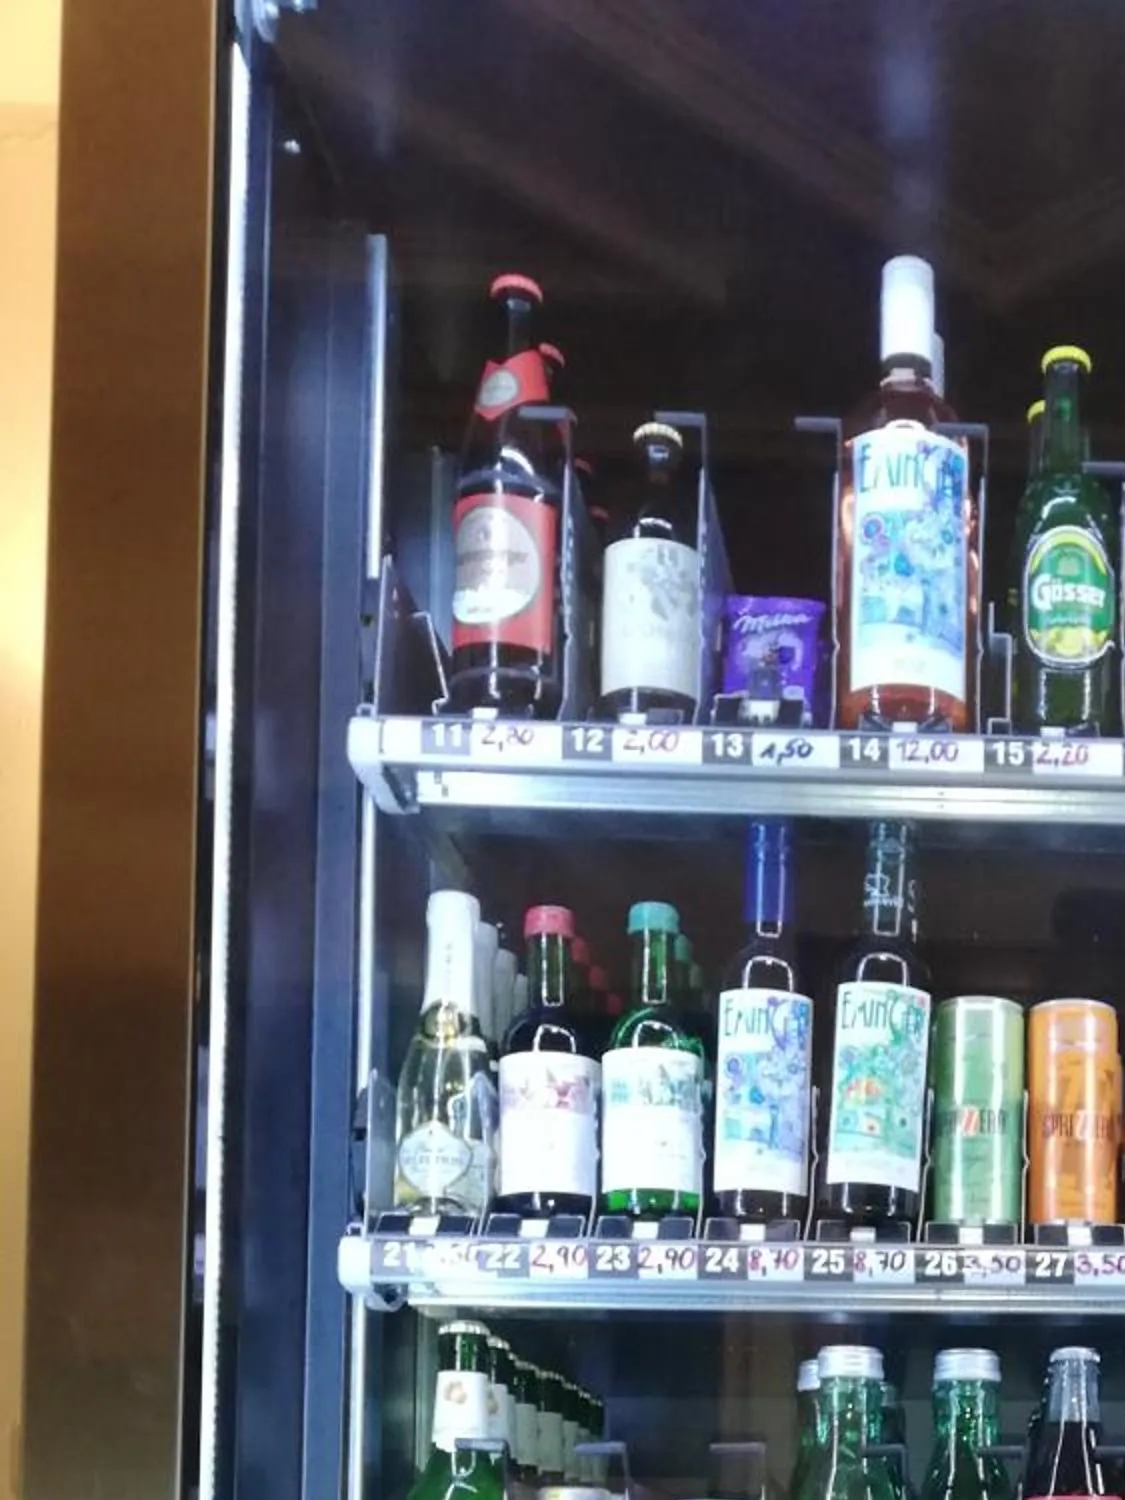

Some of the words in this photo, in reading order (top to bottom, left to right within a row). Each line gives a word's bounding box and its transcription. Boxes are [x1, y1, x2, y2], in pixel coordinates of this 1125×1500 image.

[431, 723, 463, 747] 11
[571, 727, 604, 751] 12
[711, 733, 744, 759] 13
[850, 737, 881, 762] 14
[995, 741, 1025, 765] 15
[486, 1243, 522, 1269] 22
[595, 1245, 632, 1271] 23
[705, 1249, 739, 1274] 24
[812, 1249, 845, 1274] 25
[925, 1251, 958, 1277] 26
[1035, 1252, 1067, 1277] 27
